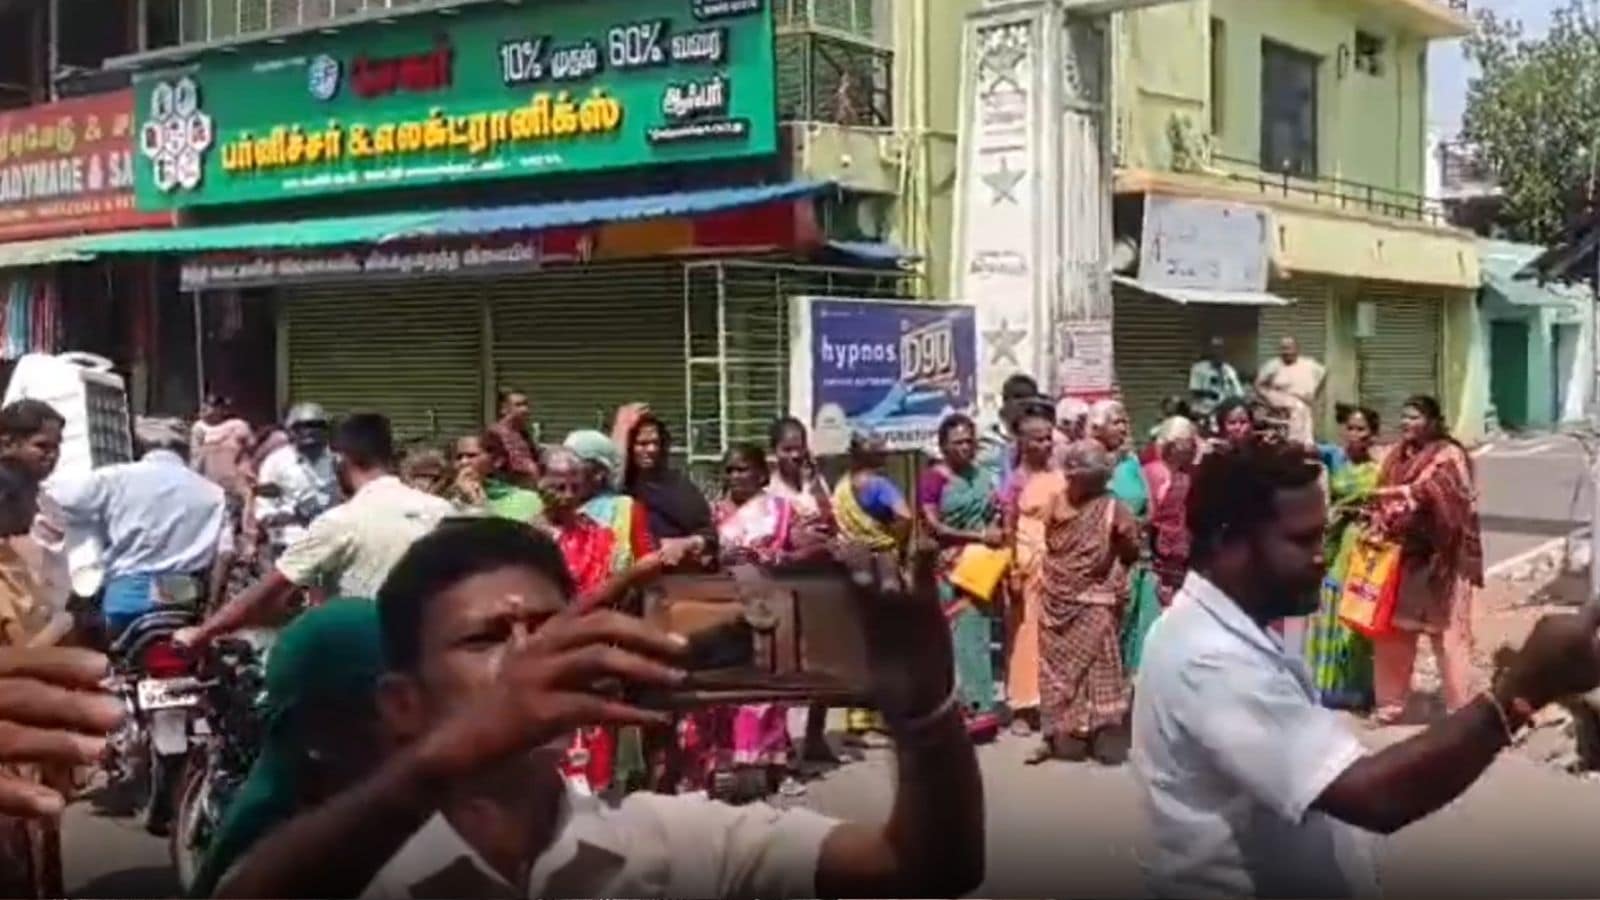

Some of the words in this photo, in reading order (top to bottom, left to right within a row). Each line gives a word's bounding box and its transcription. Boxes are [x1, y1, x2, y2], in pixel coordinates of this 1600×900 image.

[501, 38, 543, 81] 10%
[608, 22, 663, 66] 60%
[821, 334, 897, 370] hypnos
